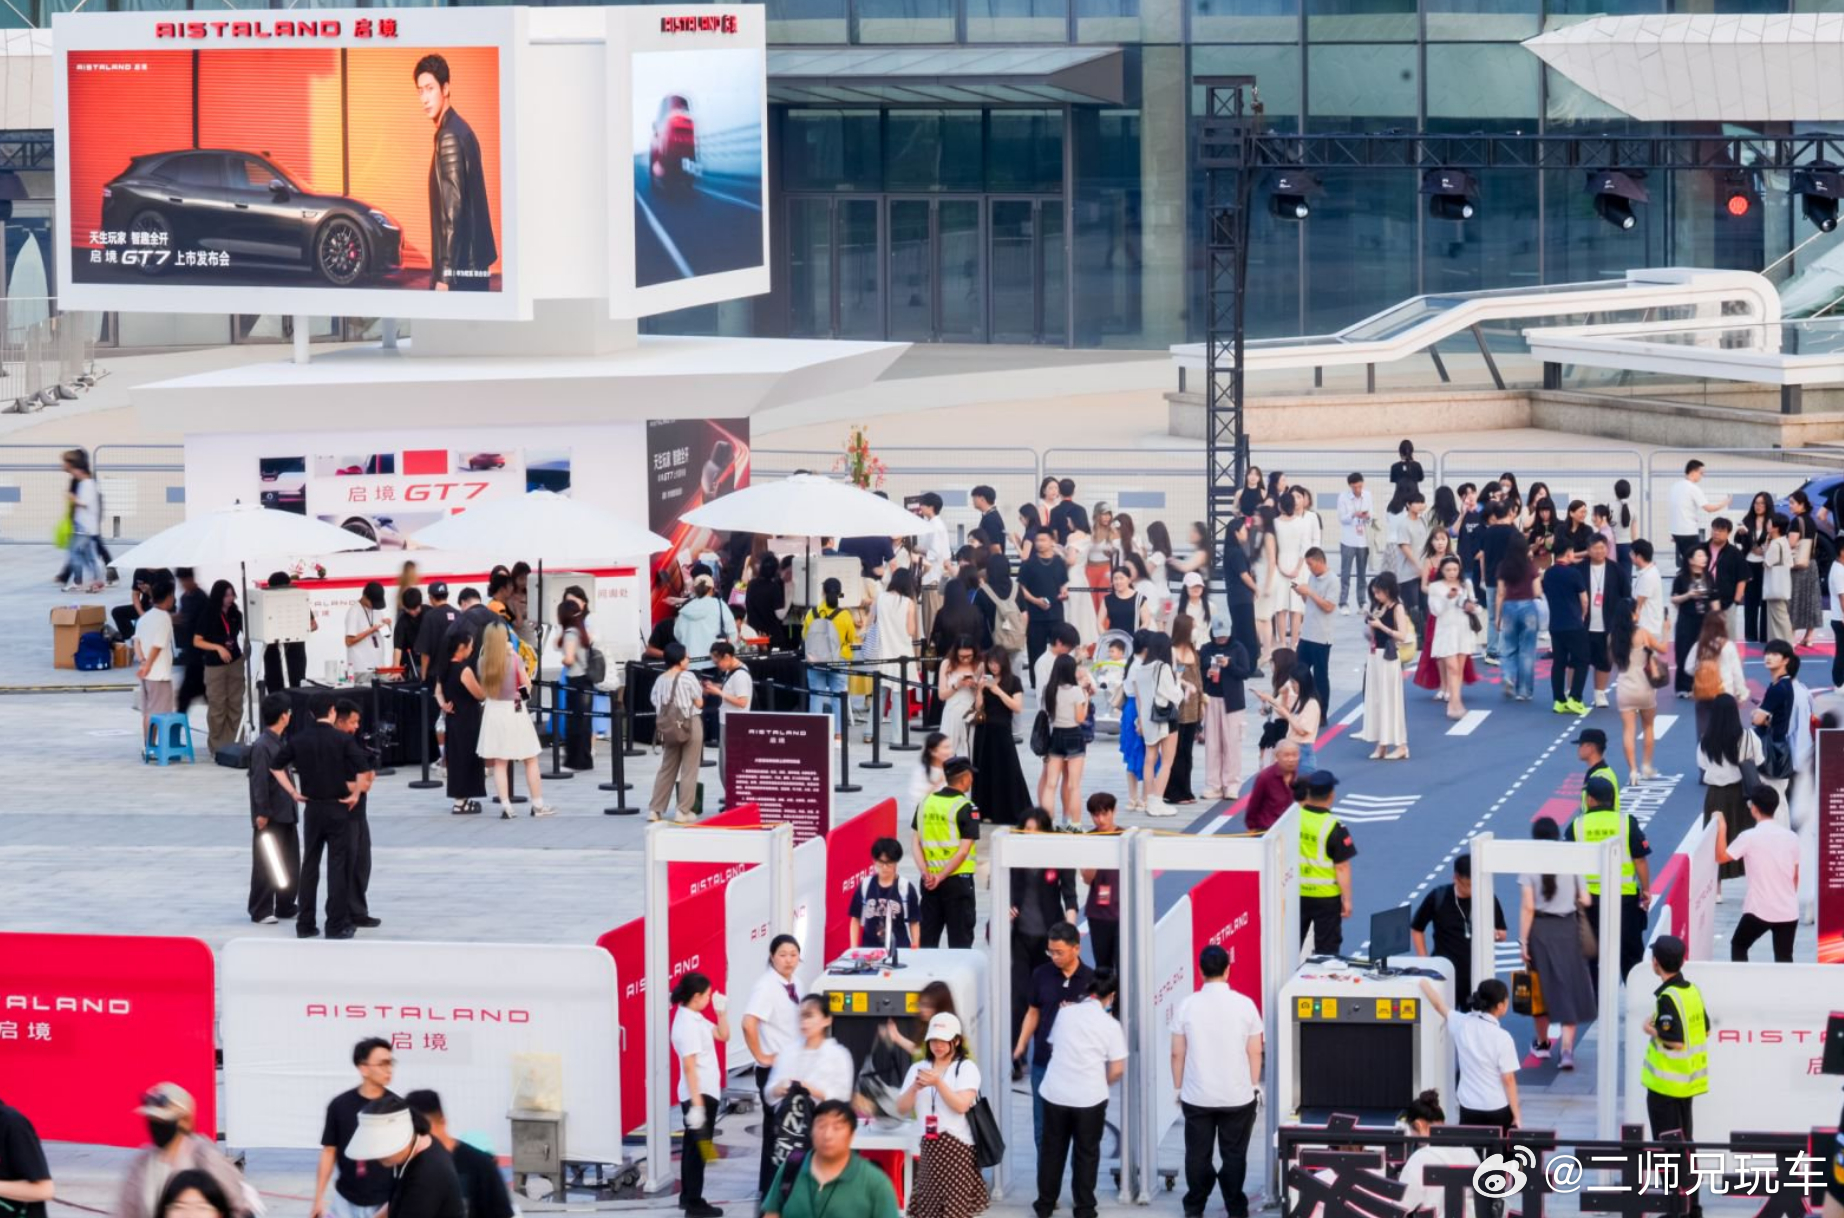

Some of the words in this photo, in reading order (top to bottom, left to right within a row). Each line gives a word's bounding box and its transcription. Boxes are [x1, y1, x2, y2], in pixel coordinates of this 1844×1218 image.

[155, 20, 341, 39] AISTALAND
[353, 18, 399, 38] 启境
[76, 63, 131, 71] AISTALAND
[89, 231, 127, 245] 天生玩家
[131, 231, 169, 246] 智趣全开
[90, 249, 118, 263] 启境
[121, 250, 171, 265] GT7
[174, 250, 231, 267] 上市发布会
[348, 485, 396, 502] 启境
[404, 482, 490, 502] GT7
[311, 599, 357, 607] ALAND
[747, 728, 807, 736] AISTALAND
[690, 863, 746, 895] AISTALAND
[0, 995, 130, 1015] ALAND
[306, 1003, 531, 1024] AISTALAND
[0, 1020, 52, 1041] 启境
[391, 1031, 448, 1051] 启境
